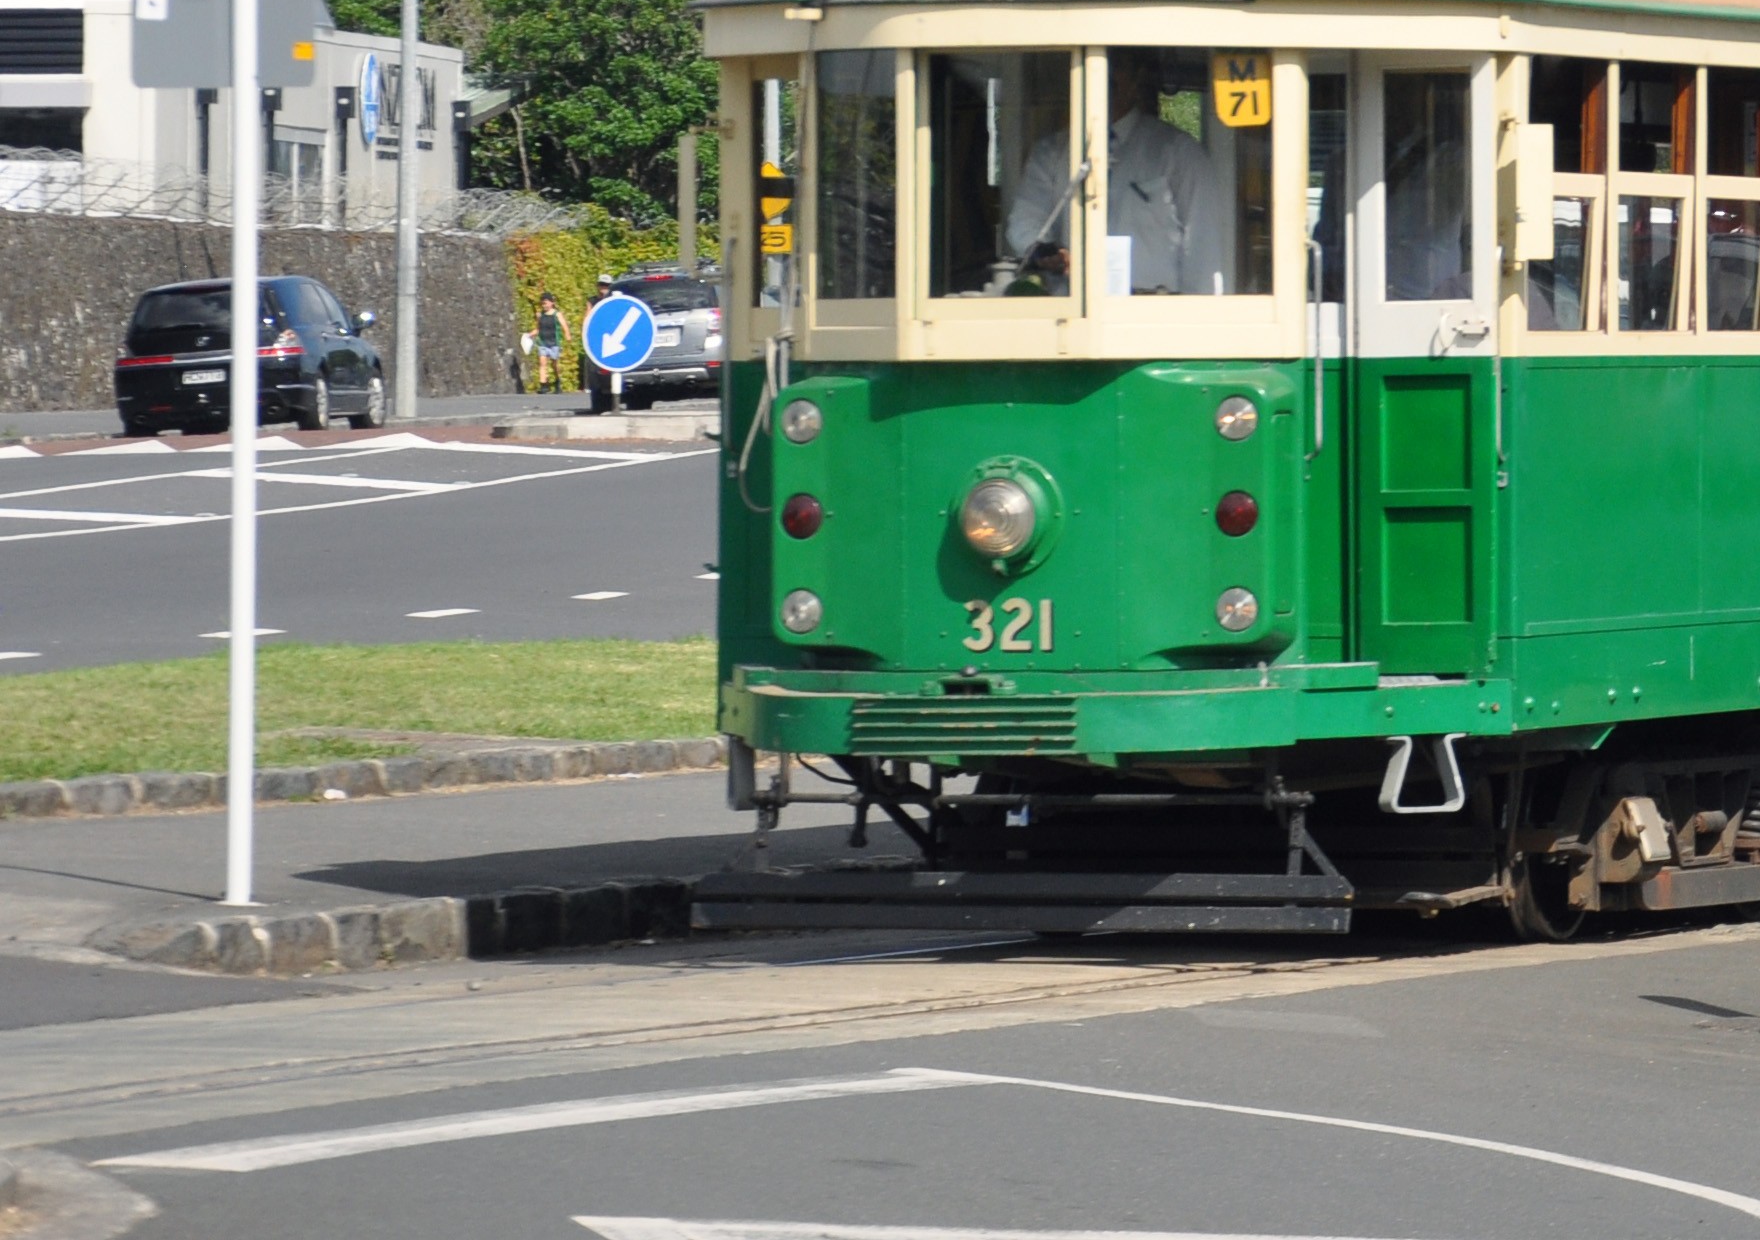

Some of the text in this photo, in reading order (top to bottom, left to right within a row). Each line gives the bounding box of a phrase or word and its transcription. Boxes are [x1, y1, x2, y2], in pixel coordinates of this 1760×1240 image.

[1228, 58, 1256, 83] M
[1230, 90, 1258, 117] 71
[962, 597, 1053, 653] 321
